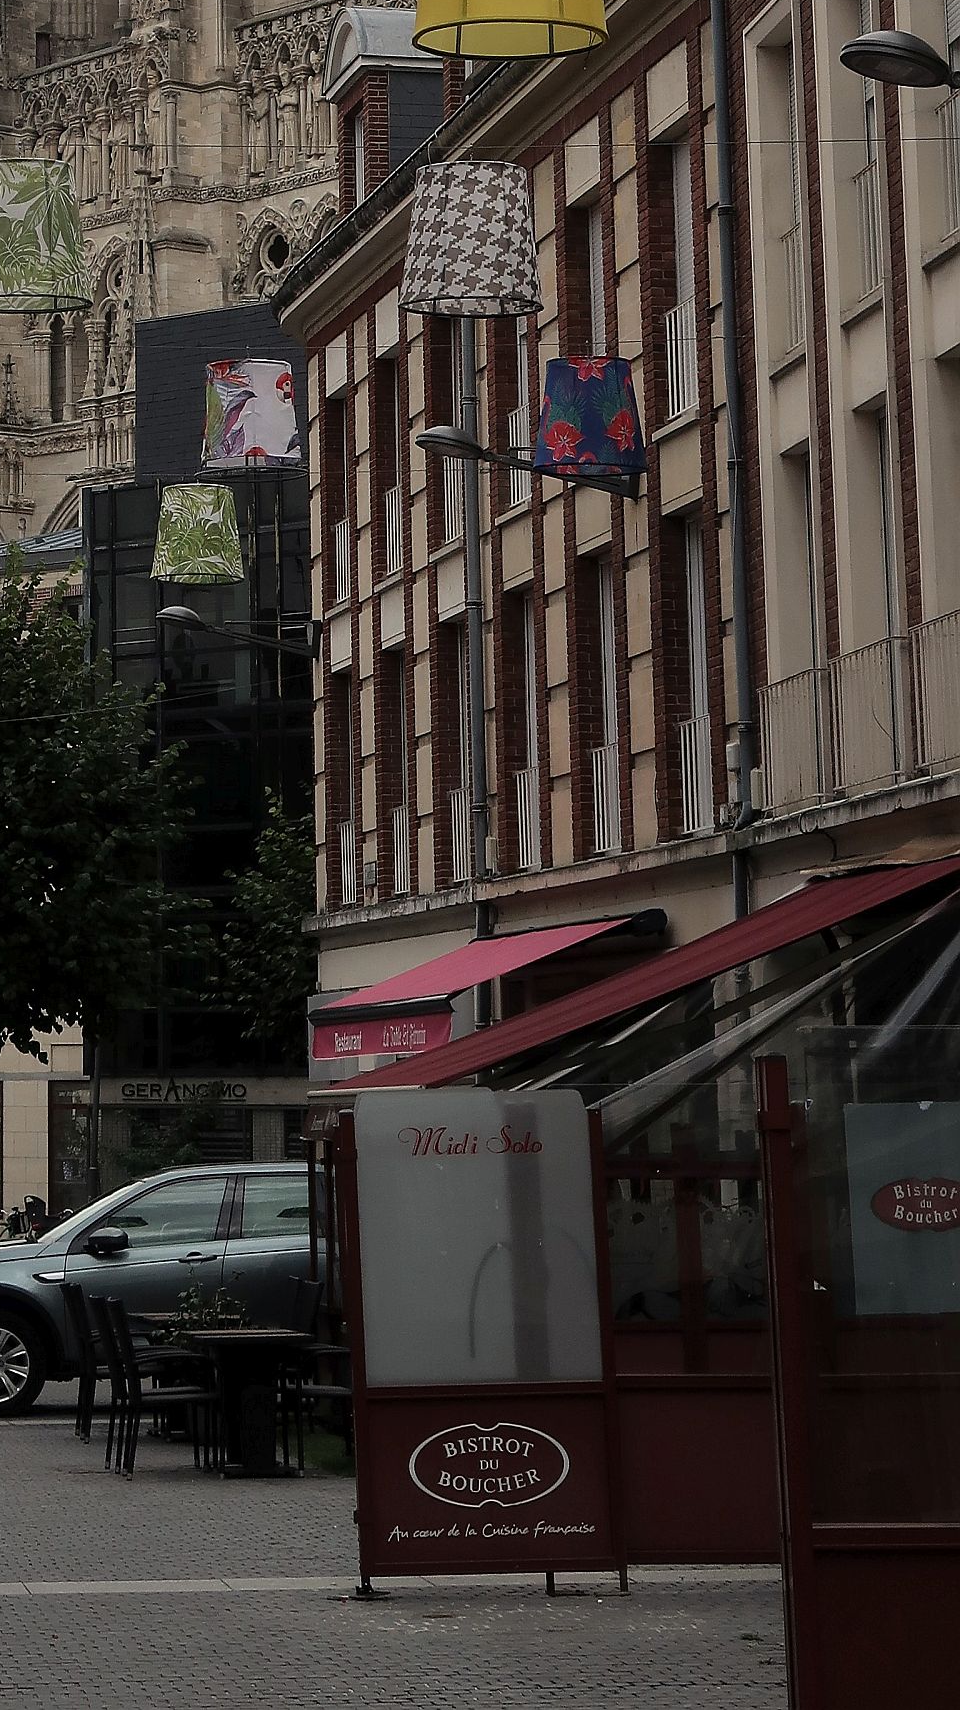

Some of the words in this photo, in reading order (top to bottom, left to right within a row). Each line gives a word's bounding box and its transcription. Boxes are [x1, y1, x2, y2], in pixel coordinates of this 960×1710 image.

[398, 1126, 478, 1156] Midi
[486, 1124, 543, 1154] Solo
[893, 1183, 958, 1199] Bistrot
[920, 1199, 932, 1208] du
[894, 1205, 958, 1224] Boucher
[443, 1436, 534, 1458] BISTROT
[479, 1459, 499, 1470] DU
[437, 1469, 541, 1494] BOUCHER
[388, 1525, 409, 1542] Au
[413, 1528, 444, 1538] cœur
[447, 1523, 461, 1537] de
[465, 1523, 477, 1538] la
[482, 1523, 530, 1538] Cuisine
